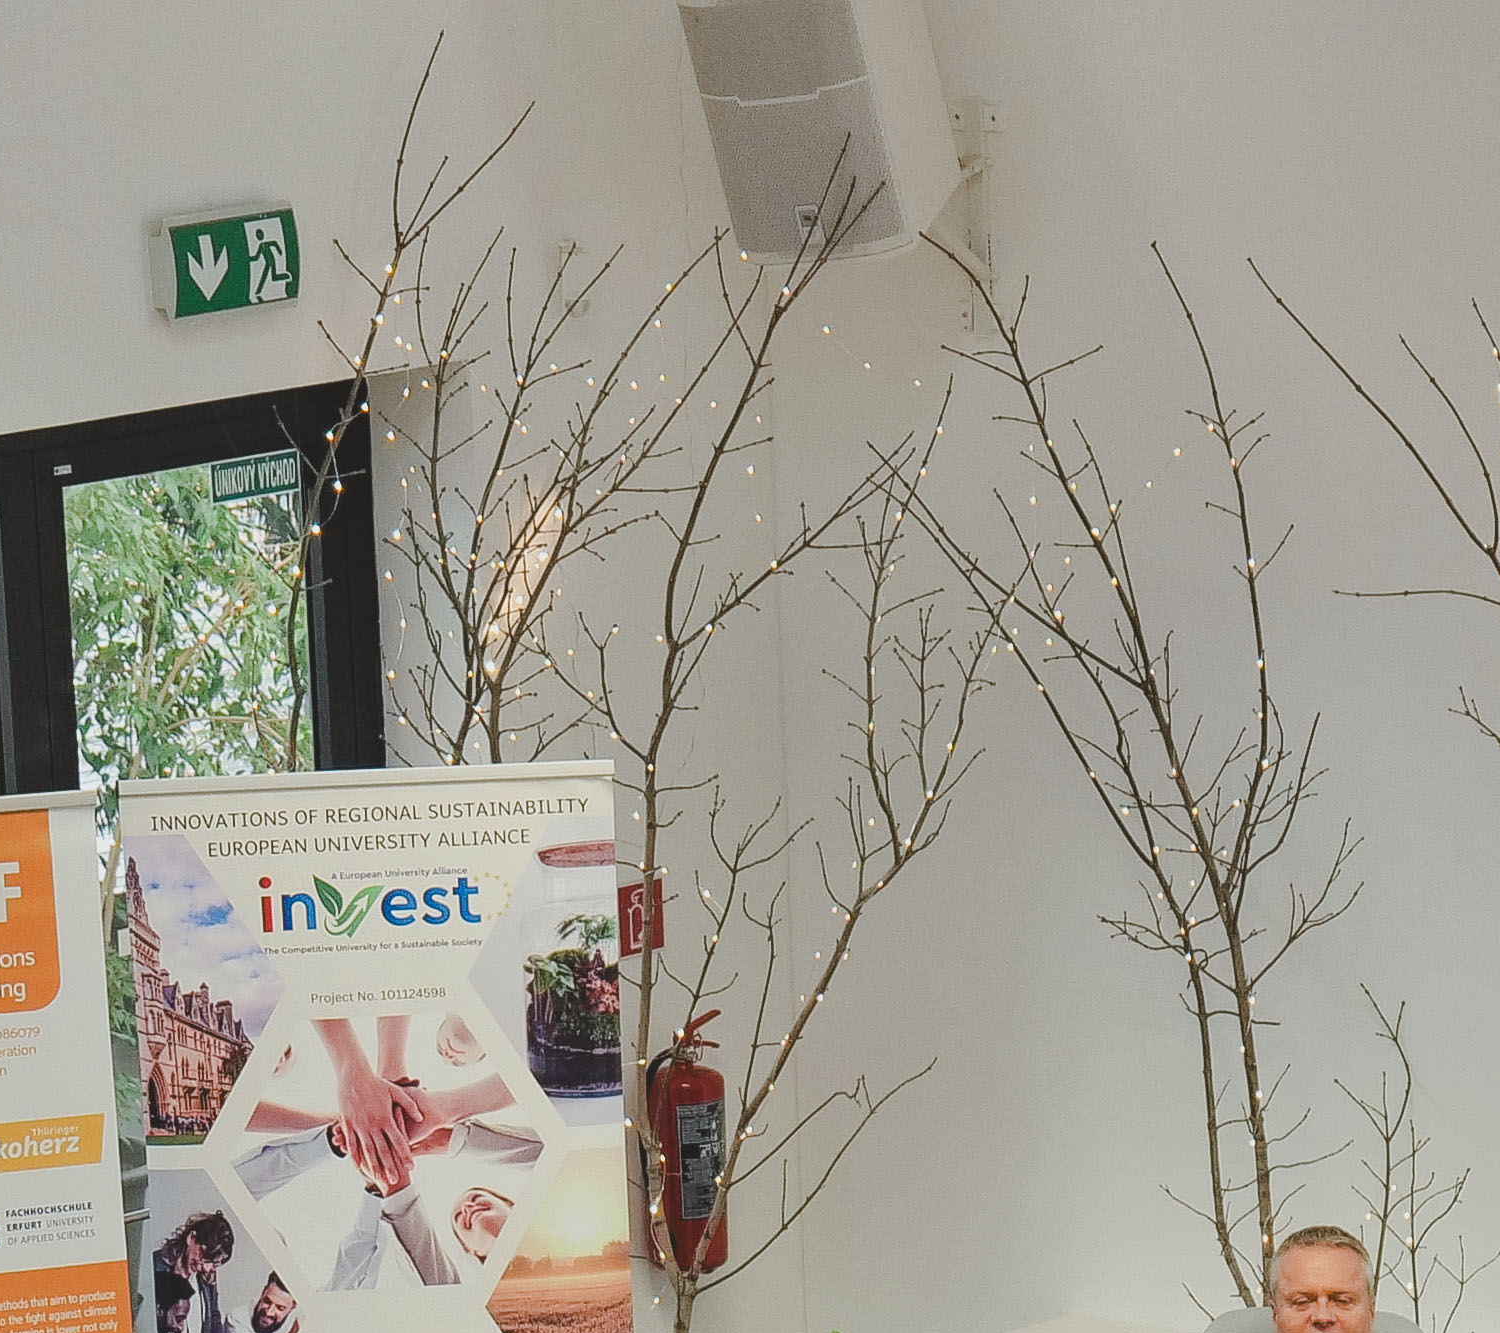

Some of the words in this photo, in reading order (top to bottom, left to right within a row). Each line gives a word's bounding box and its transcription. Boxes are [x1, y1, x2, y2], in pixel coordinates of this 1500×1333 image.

[214, 459, 256, 497] ÚNIKOVÝ
[258, 456, 296, 490] VÝCHOD
[151, 811, 287, 831] INNOVATIONS
[295, 809, 317, 824] OF
[326, 805, 421, 823] REGIONAL
[428, 798, 587, 818] SUSTAINABILITY
[208, 838, 306, 857] EUROPEAN
[314, 833, 430, 852] UNIVERSITY
[438, 829, 529, 846] ALLIANCE
[258, 876, 482, 938] invest
[311, 992, 353, 1005] Project
[358, 991, 377, 1001] No.
[380, 987, 446, 1000] 101124598
